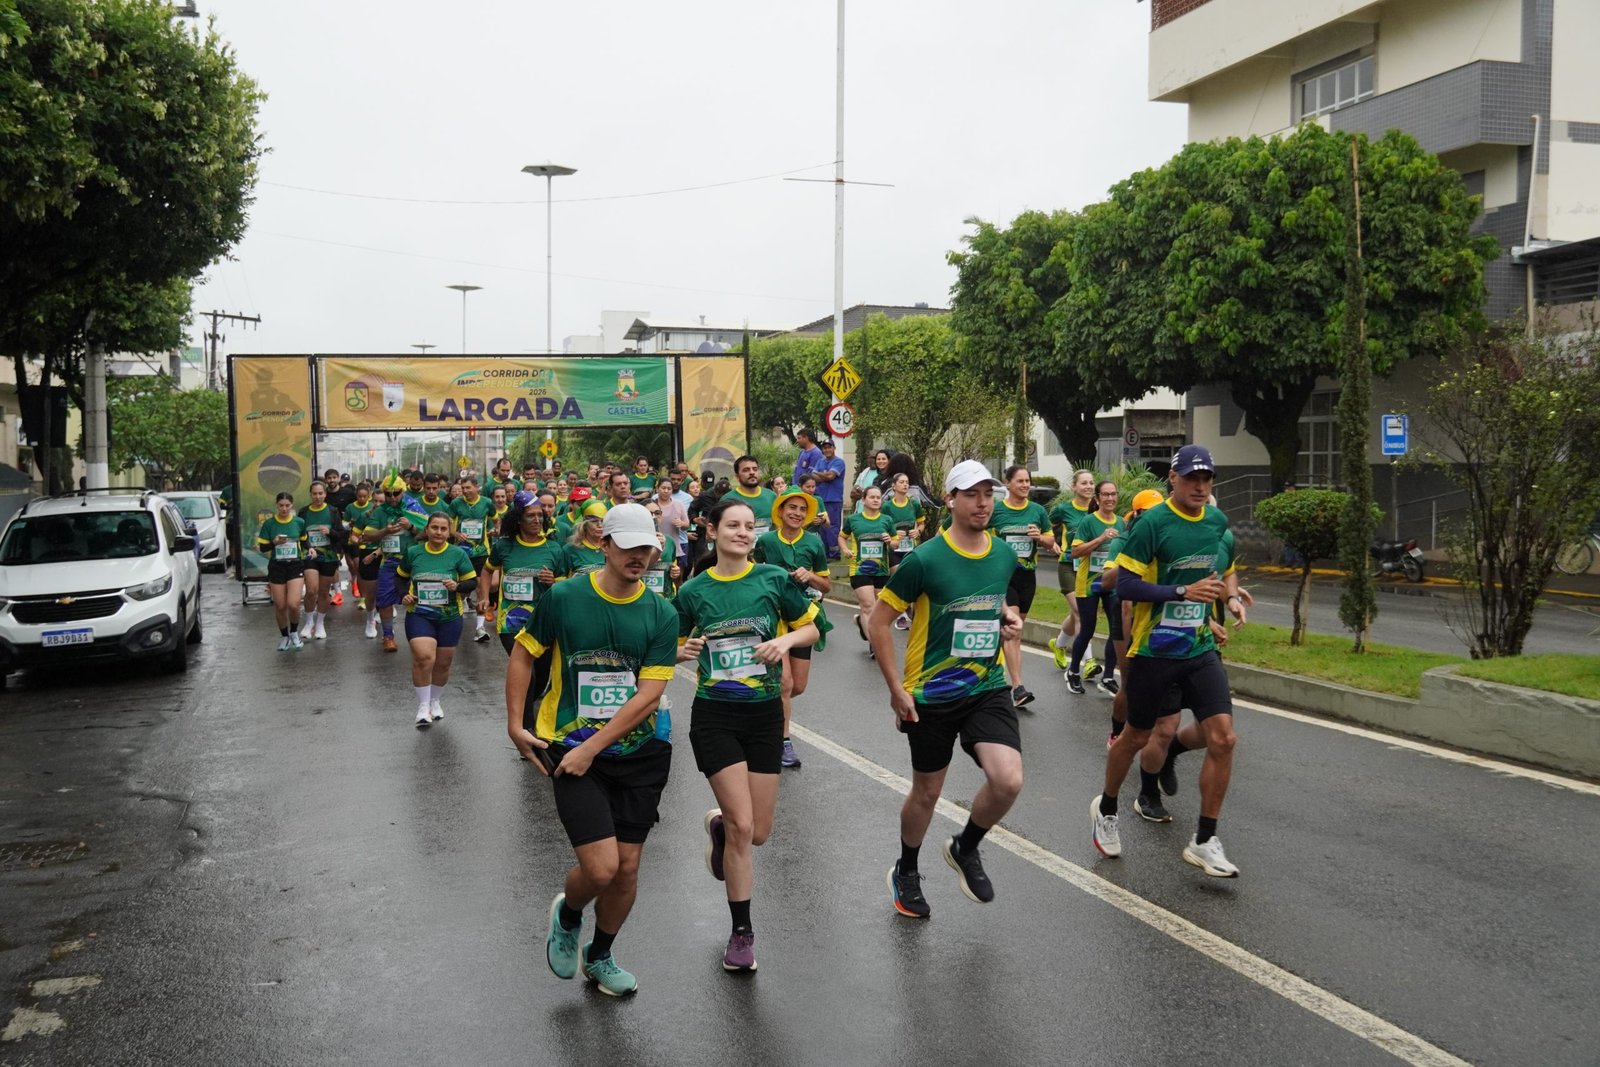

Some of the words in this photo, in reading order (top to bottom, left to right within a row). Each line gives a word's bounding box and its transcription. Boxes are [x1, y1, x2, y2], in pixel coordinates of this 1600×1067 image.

[483, 369, 529, 378] CORRIDA
[419, 396, 584, 422] LARGADA
[608, 406, 647, 415] CASTELO
[832, 410, 851, 425] 40
[1129, 432, 1135, 443] E
[1011, 542, 1030, 551] 069
[506, 583, 528, 594] 085
[424, 591, 443, 600] 164
[1173, 605, 1201, 619] 050
[721, 616, 757, 629] CORRIDA
[963, 633, 995, 649] 052
[719, 648, 752, 668] 075
[590, 687, 628, 704] 053
